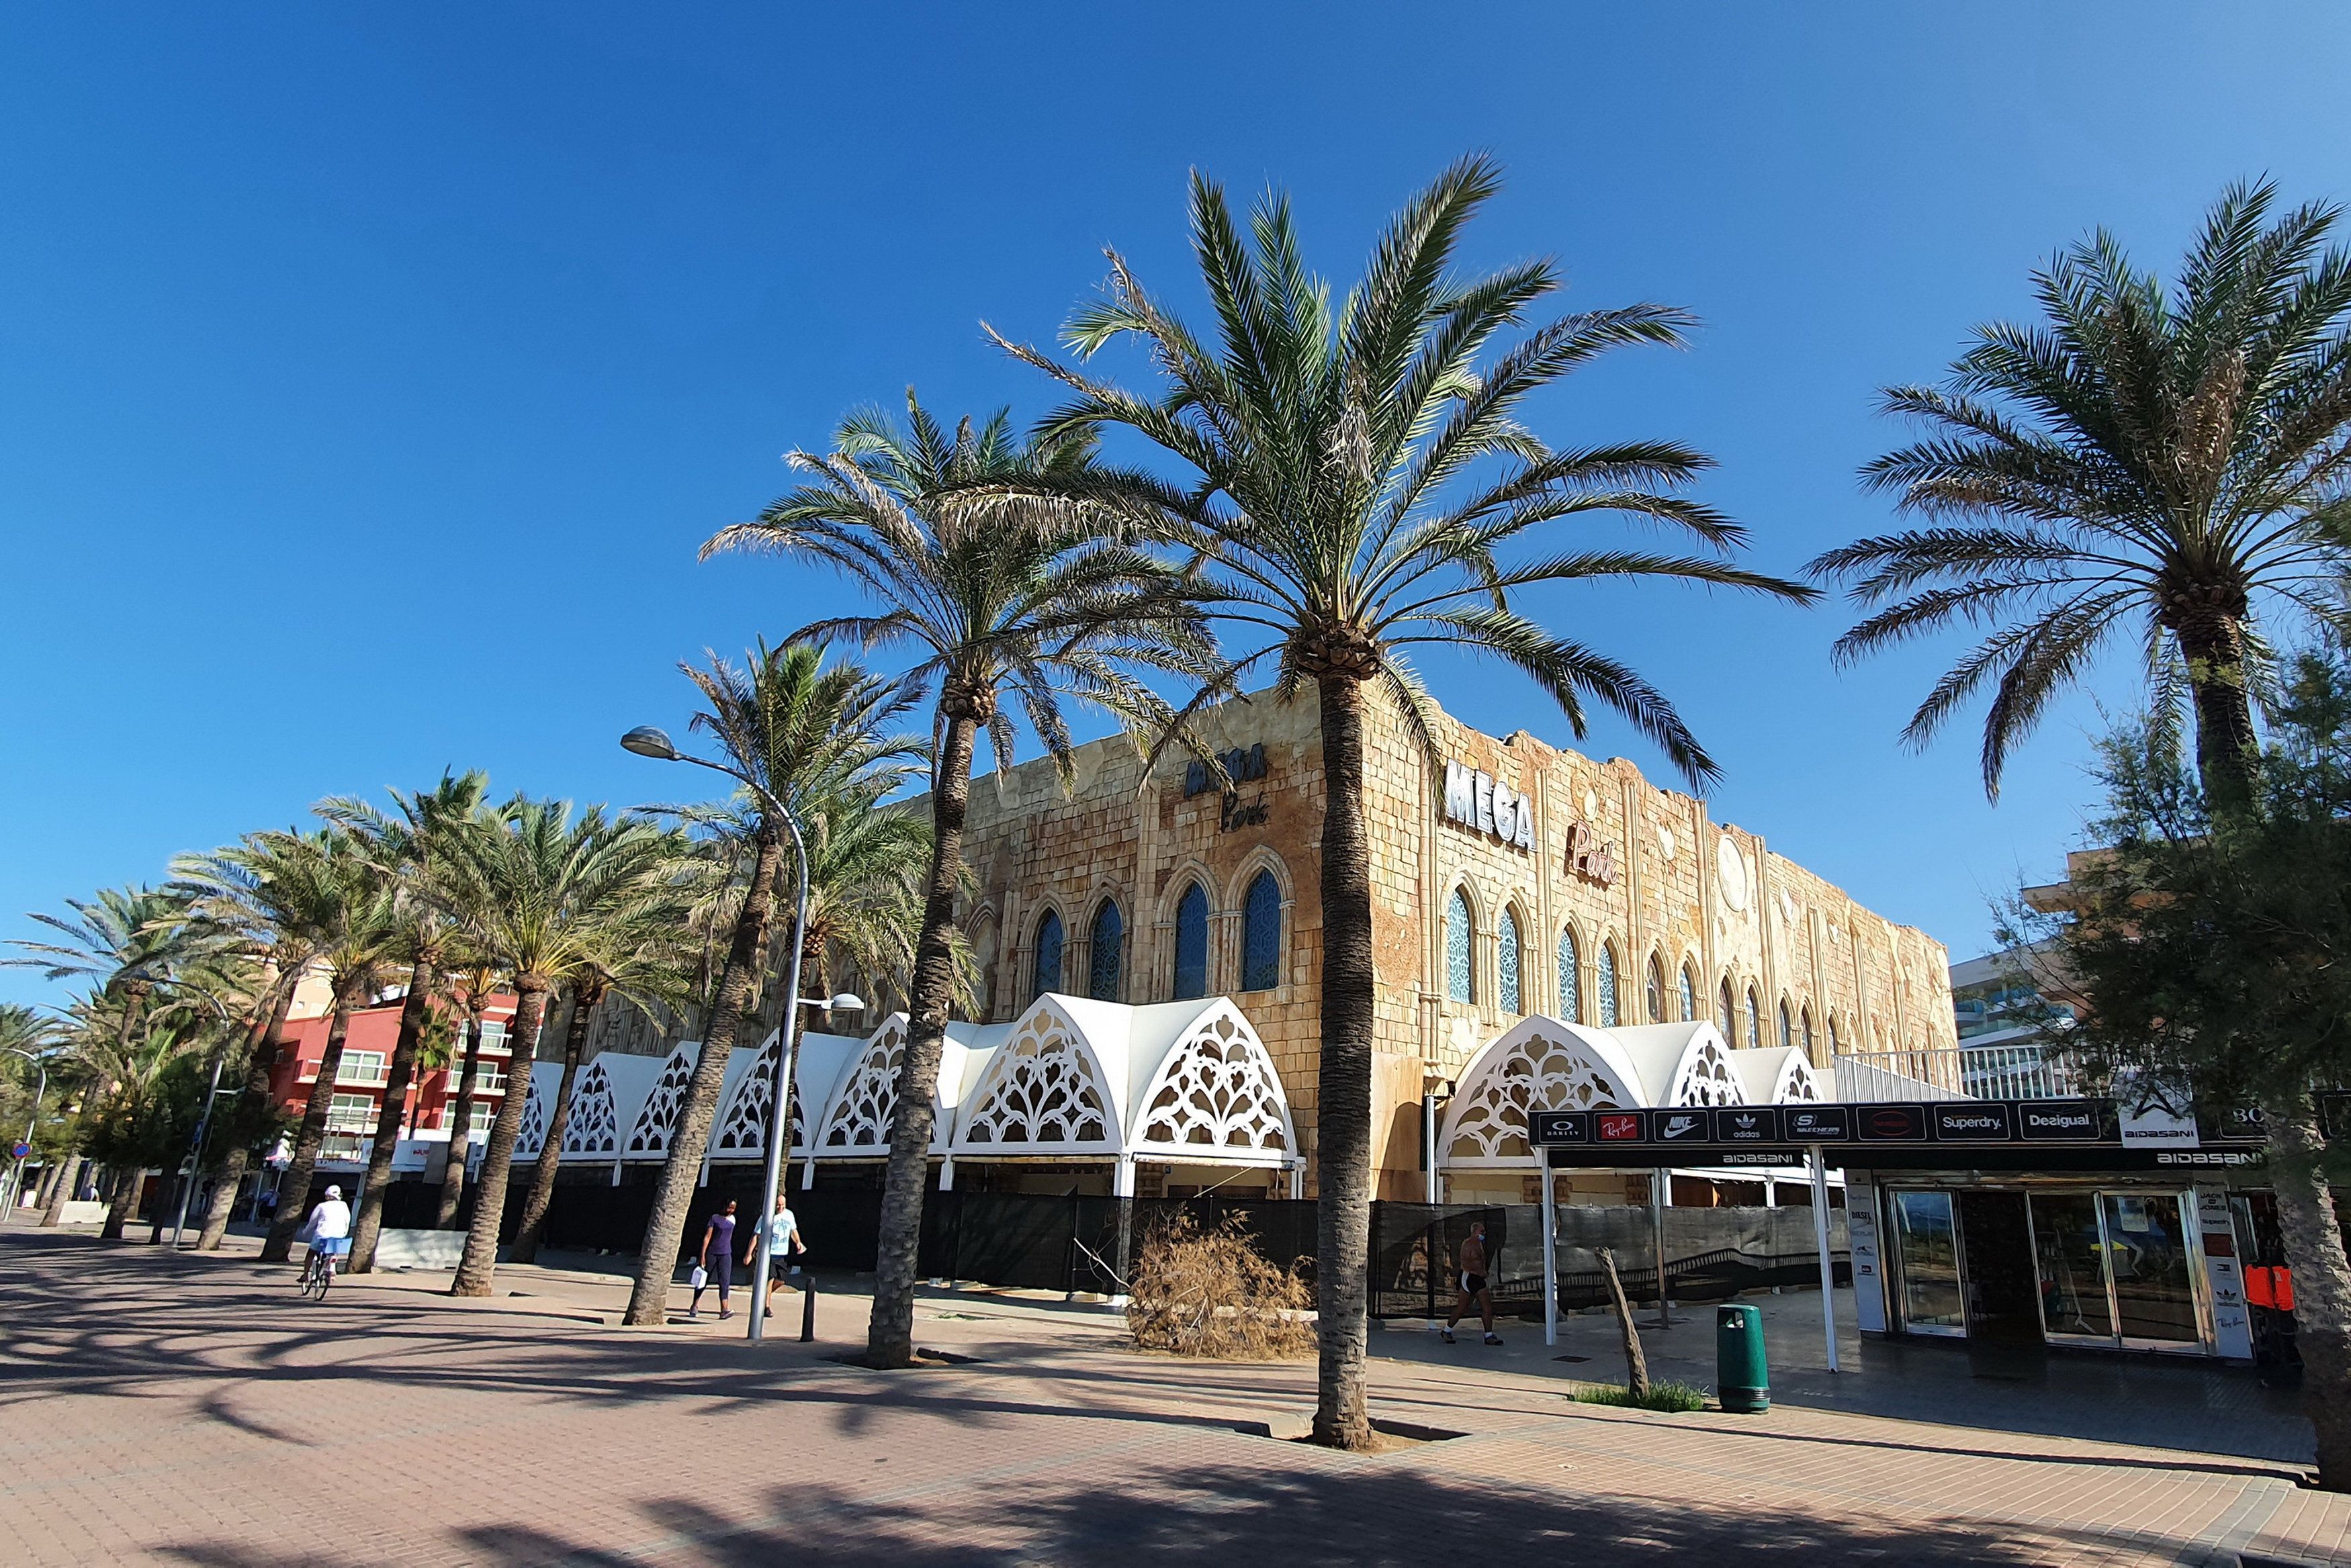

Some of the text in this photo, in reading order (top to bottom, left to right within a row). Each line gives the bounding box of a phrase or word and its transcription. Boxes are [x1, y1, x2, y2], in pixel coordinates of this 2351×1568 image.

[1446, 758, 1537, 852] MEGA
[1572, 819, 1620, 885] Park
[1670, 1116, 1692, 1128] NIKE
[2029, 1113, 2089, 1127] Desigual
